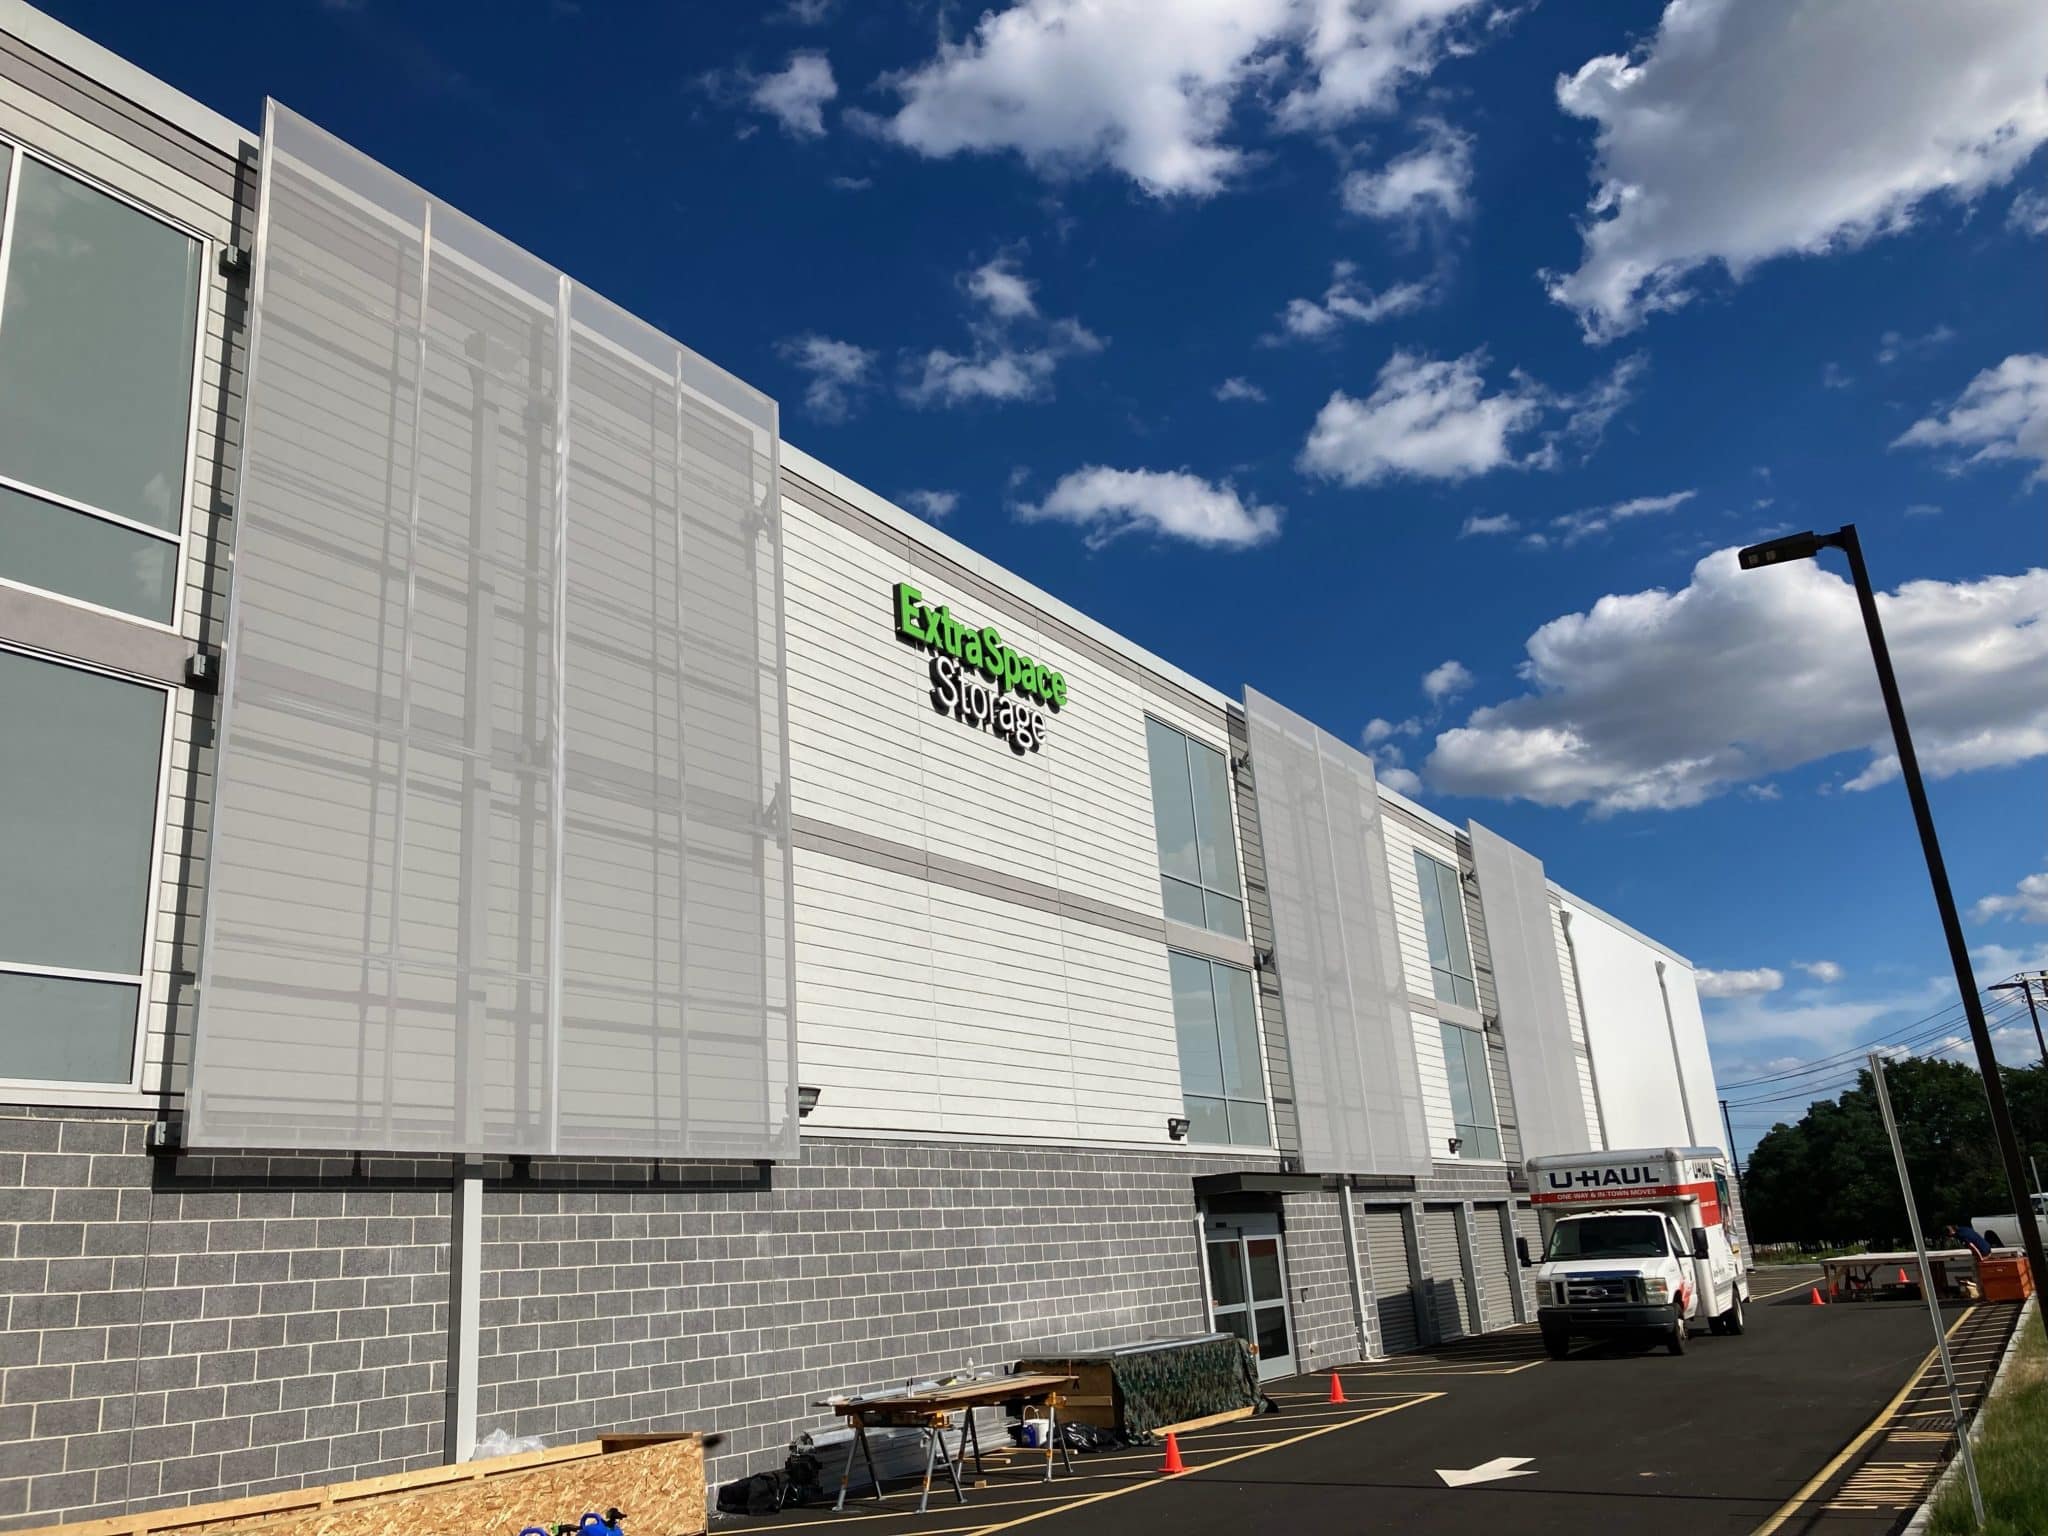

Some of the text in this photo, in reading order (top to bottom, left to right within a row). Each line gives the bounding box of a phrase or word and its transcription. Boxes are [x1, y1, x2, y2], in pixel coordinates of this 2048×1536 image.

[934, 655, 1047, 749] Storage
[1549, 1167, 1660, 1188] U-HAUL
[1630, 1188, 1657, 1196] MOVES
